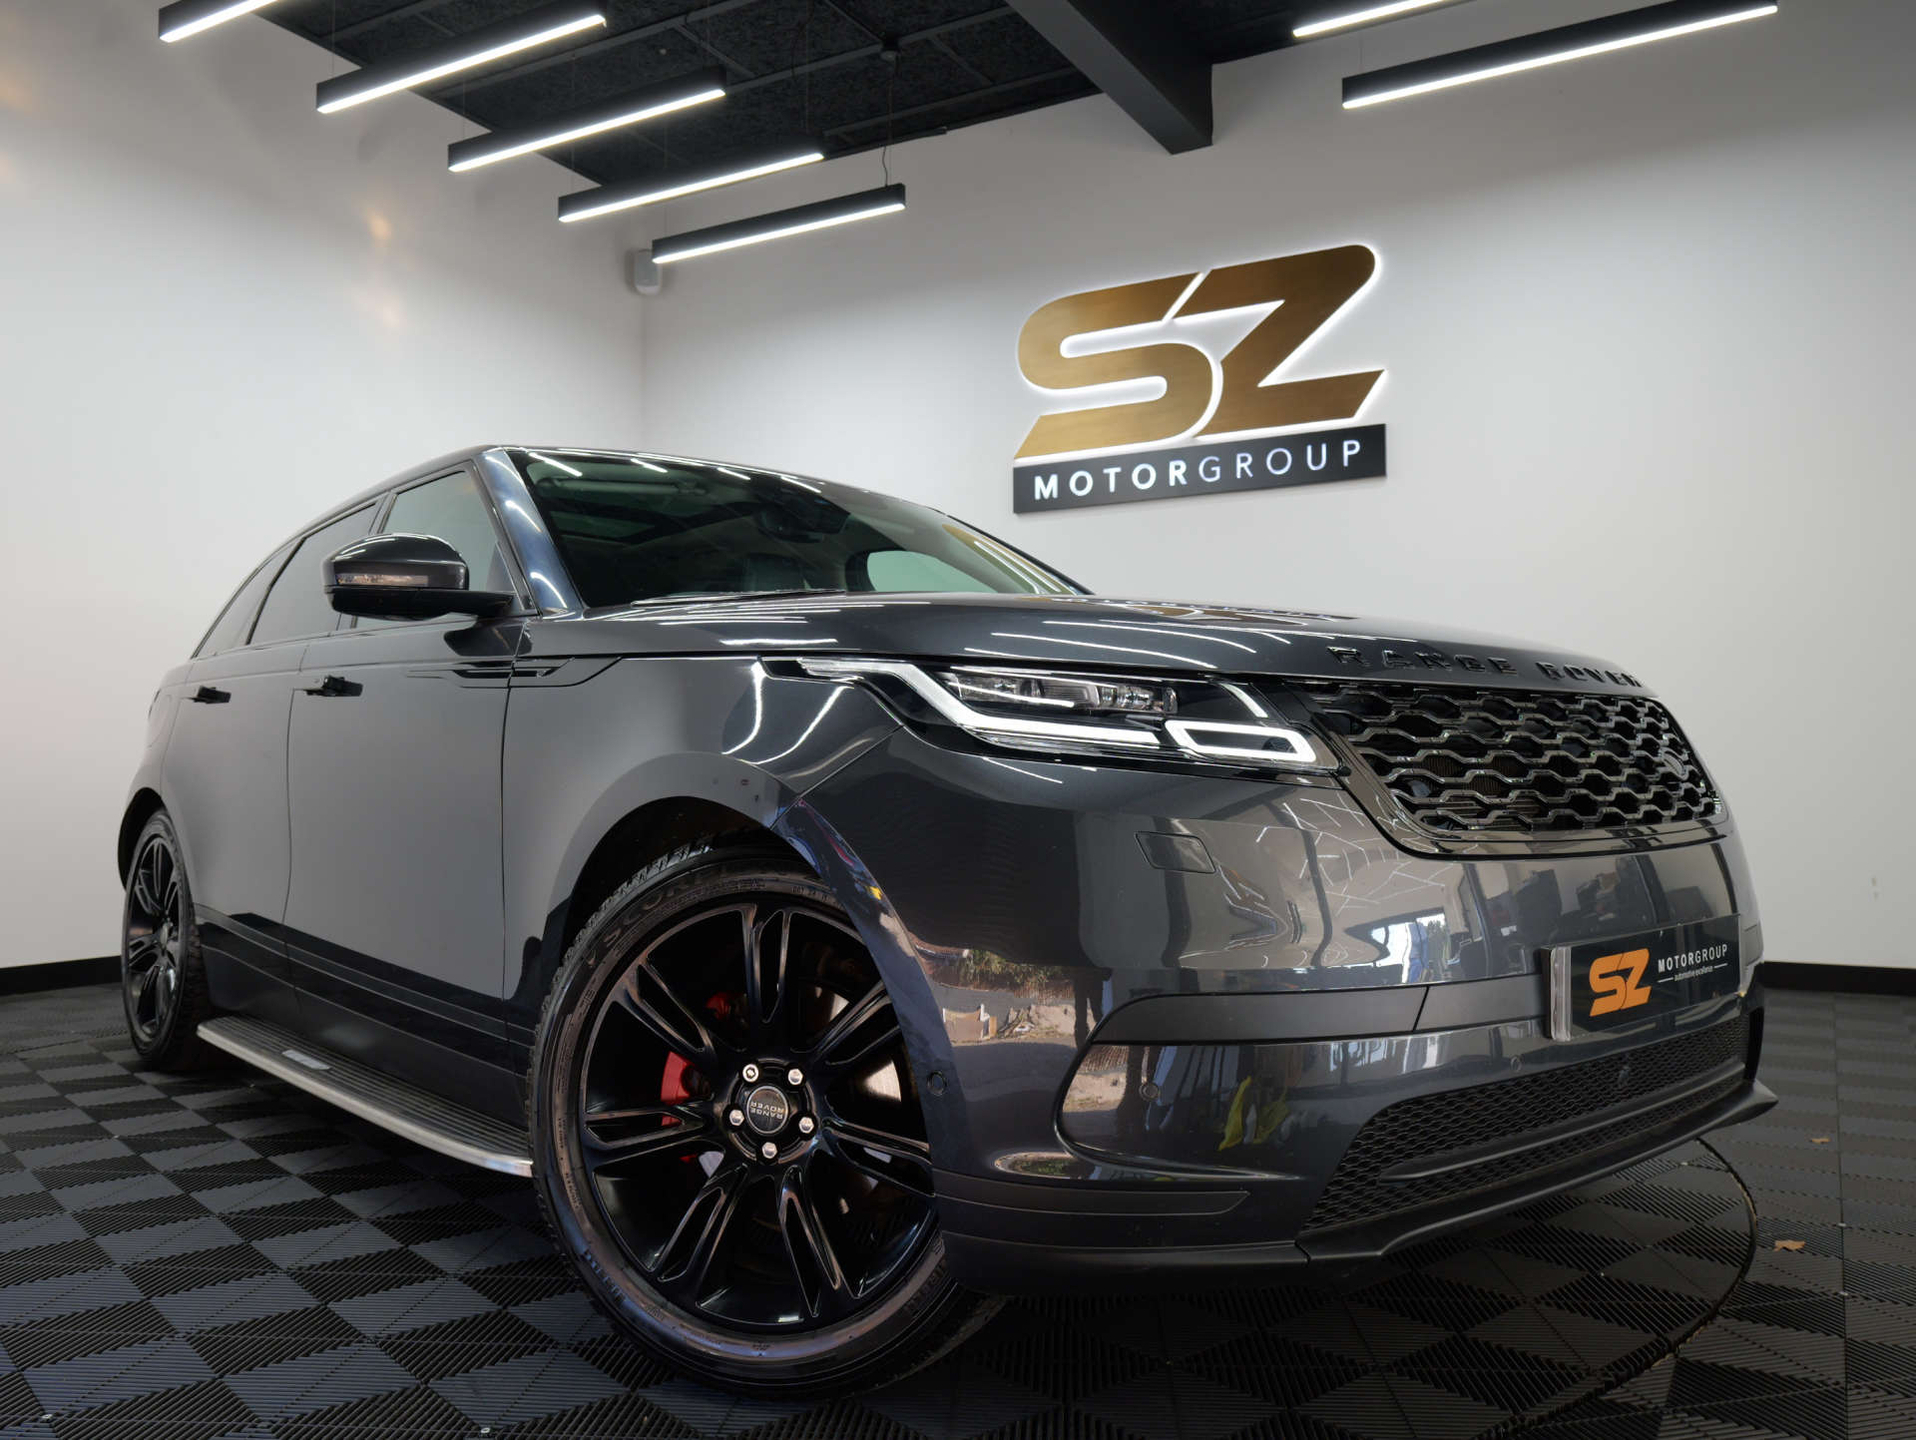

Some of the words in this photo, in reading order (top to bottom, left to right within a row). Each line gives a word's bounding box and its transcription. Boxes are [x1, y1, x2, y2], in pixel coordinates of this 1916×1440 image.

[1014, 244, 1386, 459] SZ
[1034, 439, 1361, 501] MOTORGROUP
[1657, 943, 1728, 973] MOTORGROUP
[1589, 948, 1652, 1017] SZ
[750, 1101, 785, 1113] ROVER
[750, 1107, 784, 1120] RANGE
